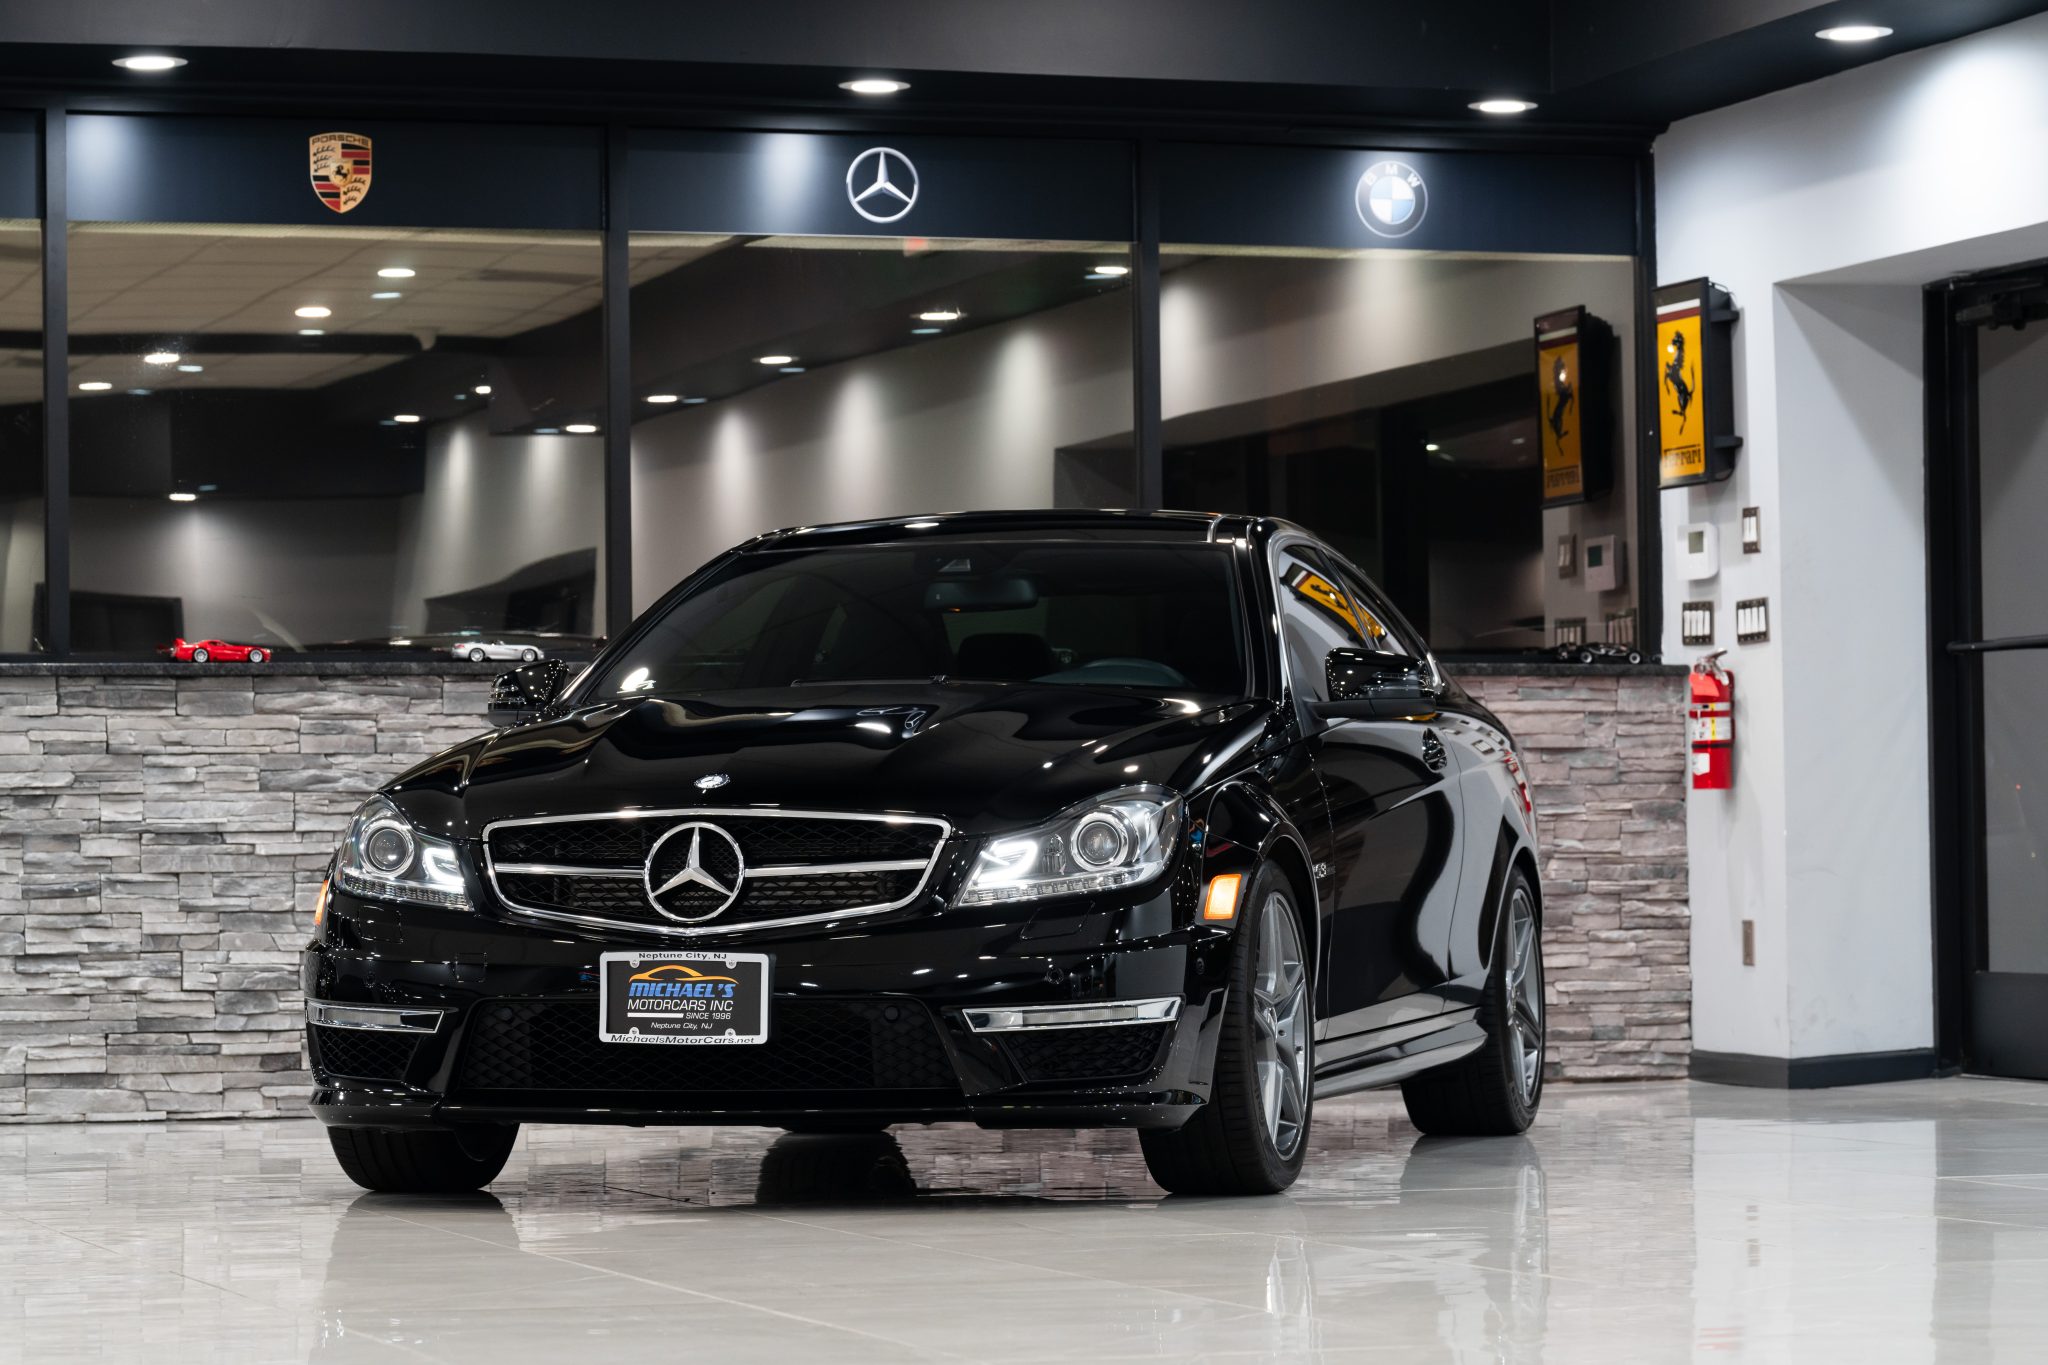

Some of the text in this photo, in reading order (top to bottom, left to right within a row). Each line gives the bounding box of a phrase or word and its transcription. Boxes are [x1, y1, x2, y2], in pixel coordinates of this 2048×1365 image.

[312, 133, 369, 146] PORSCHE
[1364, 163, 1421, 188] BMW
[638, 952, 683, 960] Neptune
[685, 952, 711, 960] City,
[628, 982, 737, 998] MICHAEL'S
[627, 998, 734, 1011] MOTORCARS INC
[685, 1011, 731, 1020] SINCE 1996
[650, 1021, 713, 1031] Neptune City, NJ
[610, 1034, 755, 1045] MichaelsMotorCars.net
